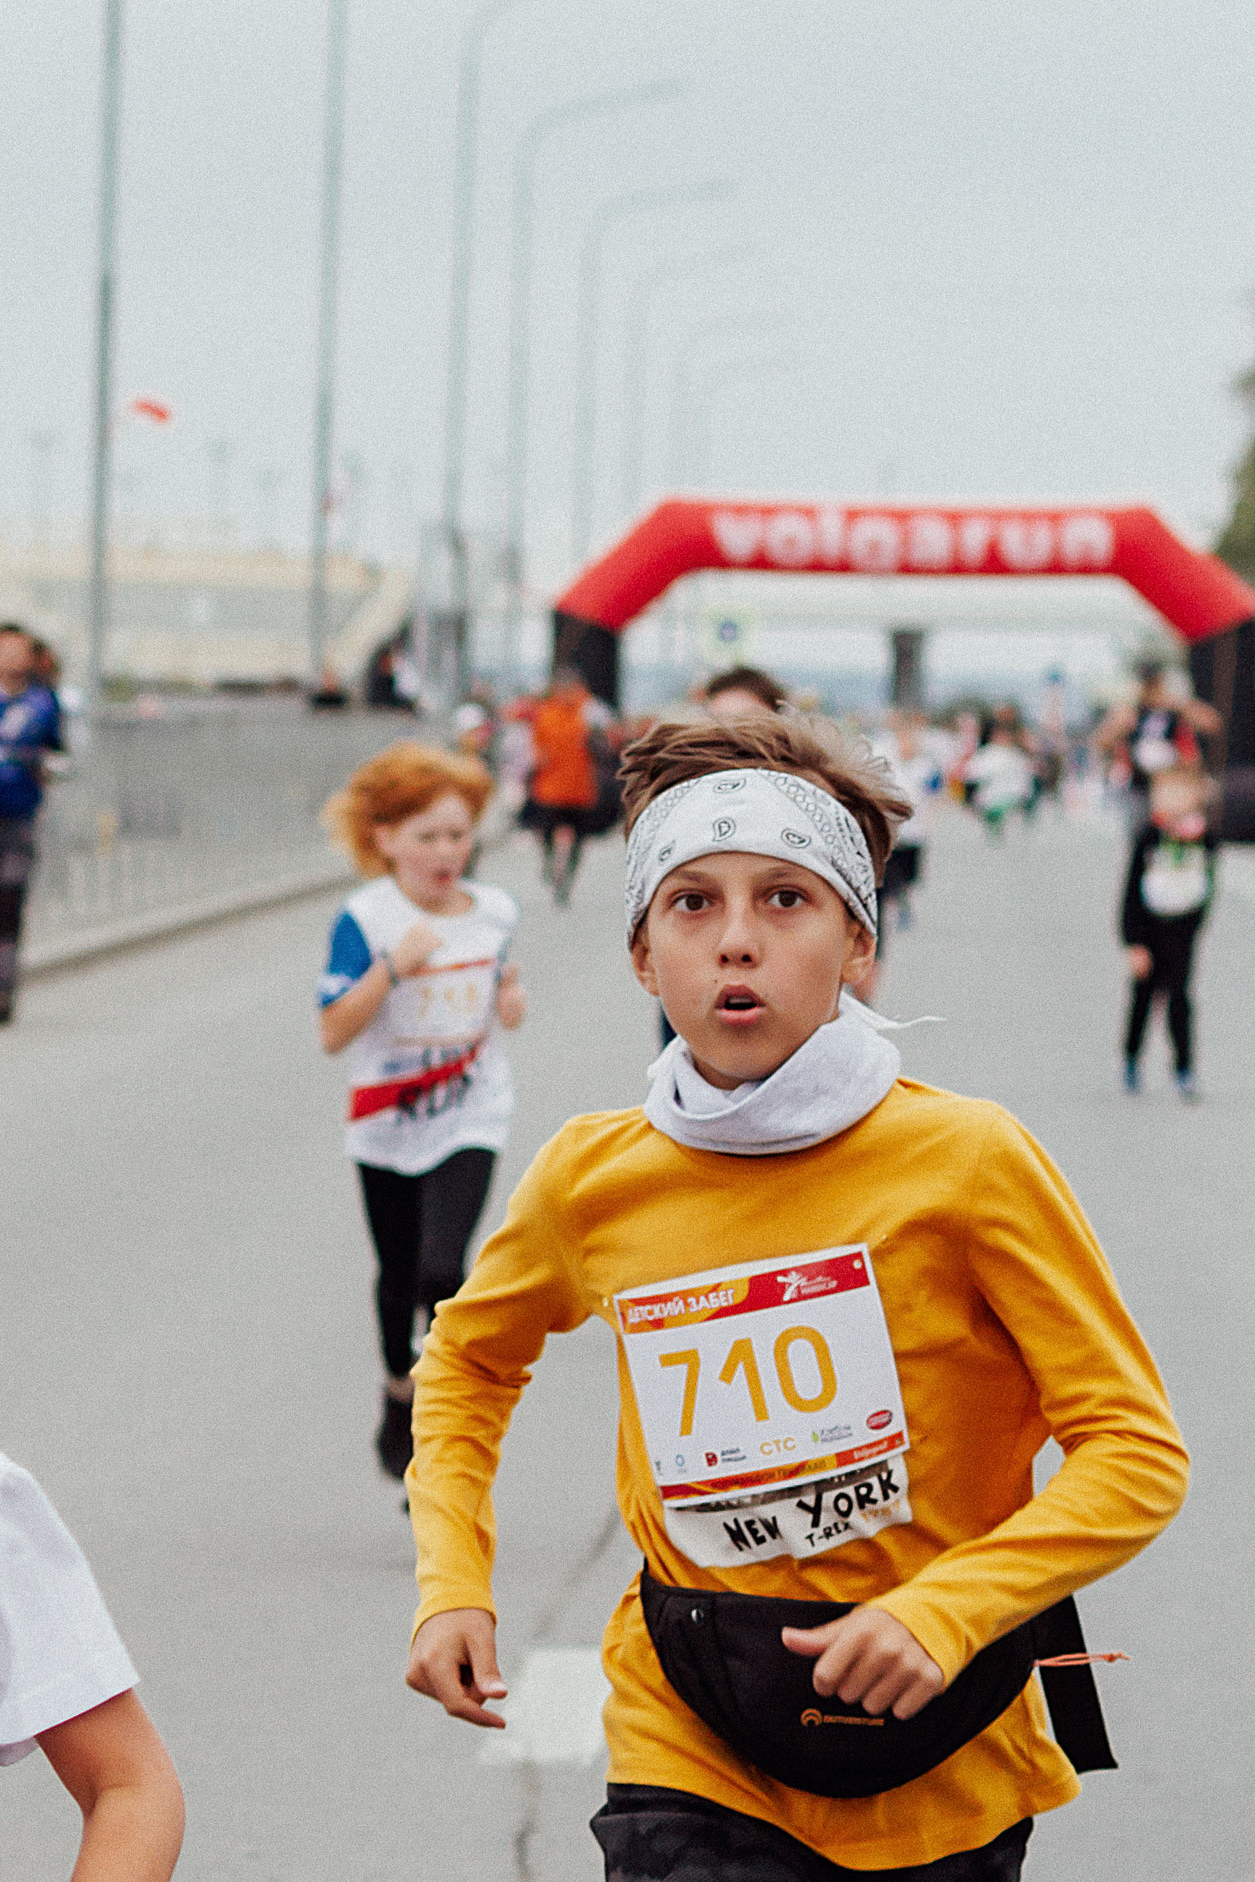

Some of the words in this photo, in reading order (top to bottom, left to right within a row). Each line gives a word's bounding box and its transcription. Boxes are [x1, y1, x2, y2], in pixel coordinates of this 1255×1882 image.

[687, 1288, 735, 1313] ЗАБЕГ
[658, 1324, 838, 1437] 710
[722, 1515, 783, 1552] NEW
[795, 1468, 901, 1529] YORK
[805, 1520, 852, 1547] T-REX
